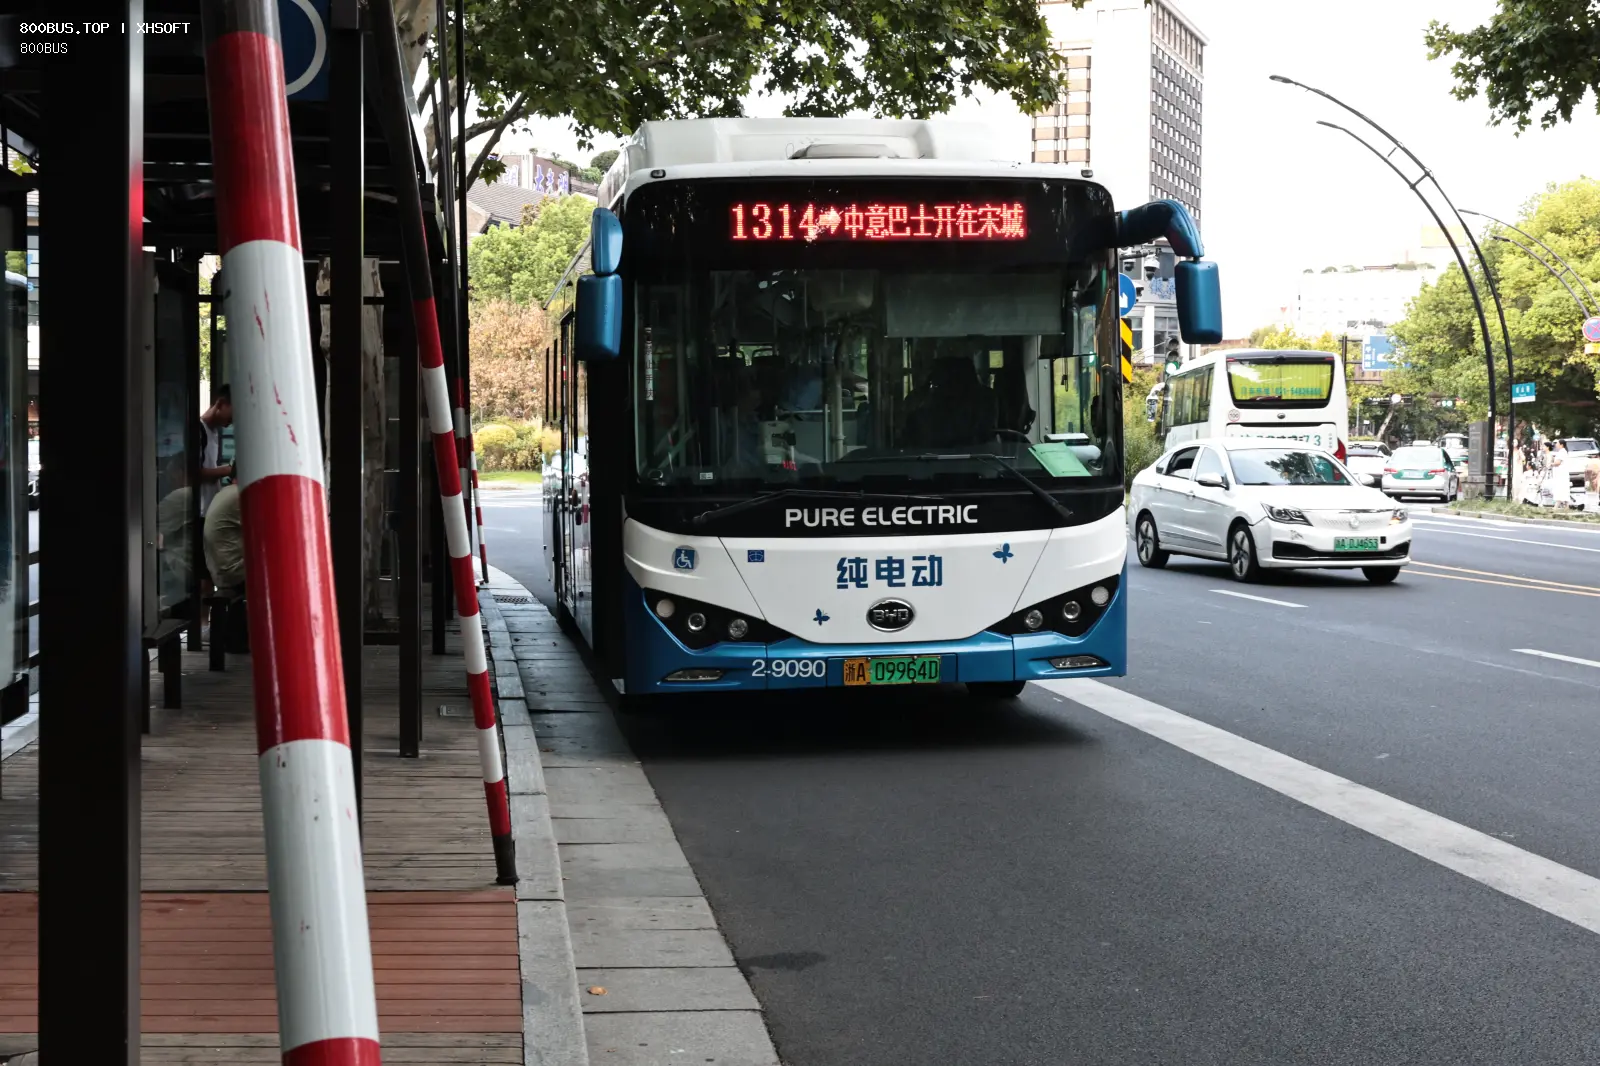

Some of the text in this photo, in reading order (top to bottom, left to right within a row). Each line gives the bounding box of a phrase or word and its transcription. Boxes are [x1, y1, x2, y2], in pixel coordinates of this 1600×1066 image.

[732, 203, 1025, 240] 1314 中意巴士开往宋城
[785, 505, 978, 528] PURE ELECTRIC
[837, 555, 943, 588] 纯电动
[873, 608, 909, 622] BYD
[751, 660, 827, 678] 2-9090
[845, 661, 939, 682] 浙A 09964D
